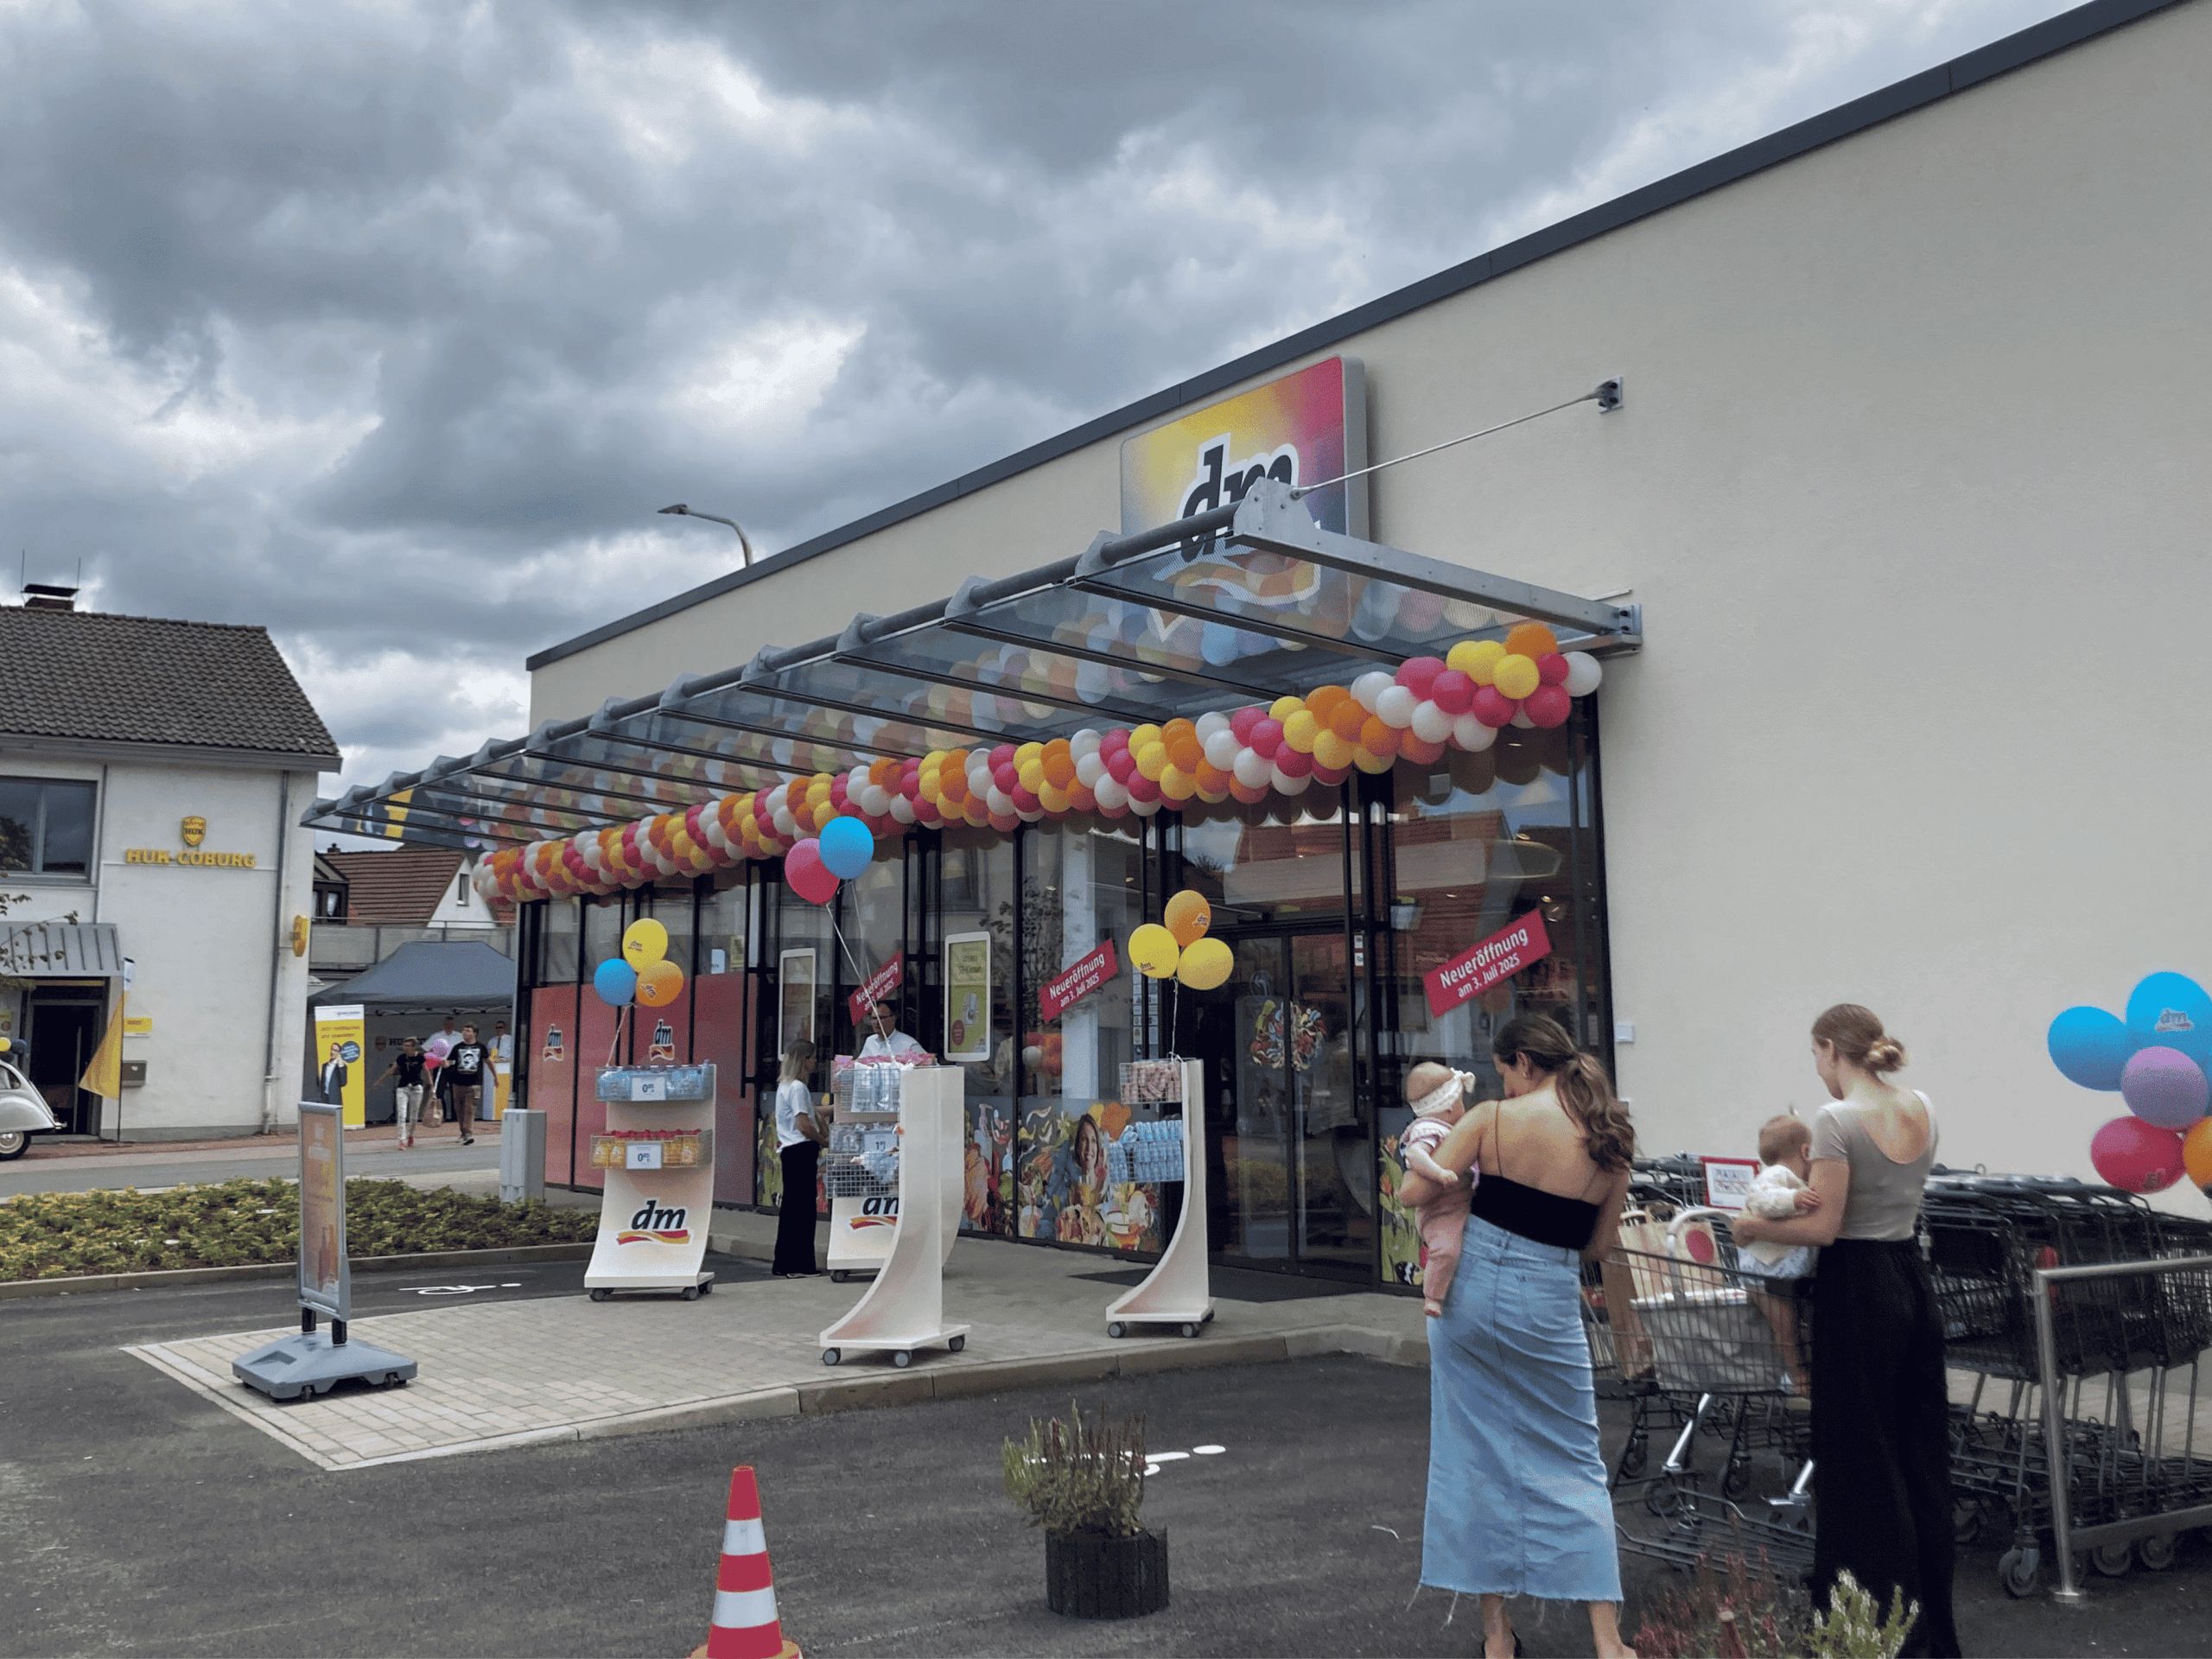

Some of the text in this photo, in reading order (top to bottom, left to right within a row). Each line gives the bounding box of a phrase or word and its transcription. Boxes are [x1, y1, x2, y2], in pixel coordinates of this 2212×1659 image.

[126, 849, 255, 868] HUK-COBURG
[1440, 928, 1529, 988] Neueröffnung
[1049, 953, 1104, 1000] Neueröffnung
[1060, 972, 1100, 1007] am 3. Juli 2025
[1458, 953, 1520, 998] am 3. Juli 2025
[2161, 1009, 2187, 1025] dm
[548, 1026, 562, 1047] dm
[655, 1020, 672, 1046] dm
[631, 1199, 685, 1230] dm
